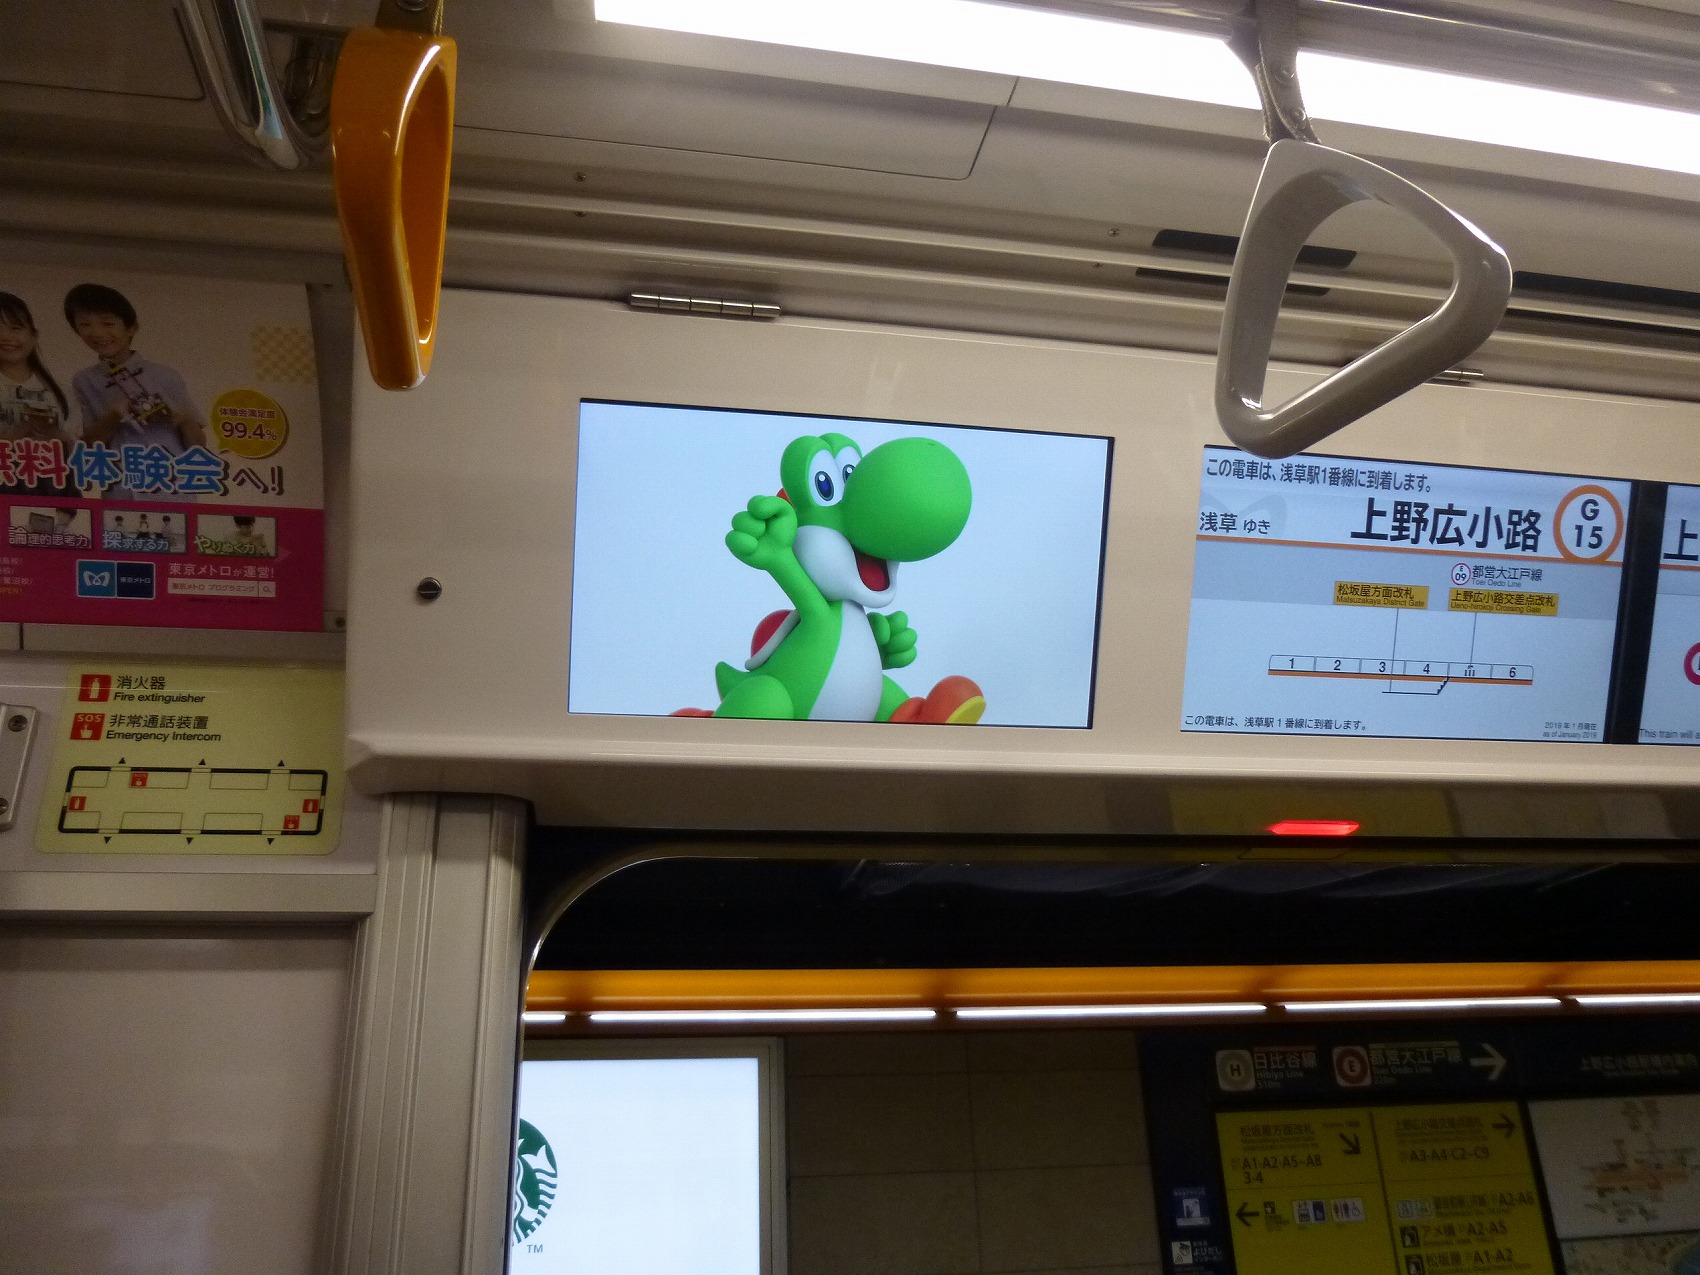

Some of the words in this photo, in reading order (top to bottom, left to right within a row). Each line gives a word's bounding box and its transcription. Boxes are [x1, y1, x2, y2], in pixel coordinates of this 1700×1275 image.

[219, 407, 276, 420] 体験会満足度
[221, 420, 277, 441] 99.4%
[1206, 458, 1432, 493] この電車は、浅草駅1番線に到着します。
[1580, 498, 1600, 521] G
[1199, 511, 1238, 534] 浅草
[1243, 519, 1271, 535] ゆき
[1350, 497, 1542, 553] 上野広小路
[8, 526, 89, 548] 論理的思考力
[103, 531, 169, 552] 探求する力
[1575, 524, 1603, 550] 15
[1663, 518, 1699, 562] 上
[1455, 573, 1467, 582] 09
[1472, 565, 1543, 582] 都営大江戸線
[1337, 583, 1415, 600] 松坂屋方面改札
[1451, 589, 1556, 608] 上野広小路交差点改札
[1336, 595, 1382, 606] Matsuzakaya
[1383, 598, 1407, 607] District
[1408, 600, 1425, 608] Gate
[1495, 604, 1524, 614] Crossing
[1526, 606, 1541, 614] Gate
[1289, 658, 1295, 669] 1
[1333, 659, 1341, 672] 2
[1378, 661, 1386, 673] 3
[1422, 663, 1430, 675] 4
[1508, 667, 1516, 678] 6
[117, 675, 166, 691] 消火器
[114, 691, 135, 702] Fire
[137, 693, 206, 705] extinguisher
[77, 714, 102, 723] SOS
[109, 714, 209, 730] 非常通話装置
[106, 730, 170, 743] Emergency
[172, 731, 222, 742] Intercom
[1558, 731, 1581, 740] January
[1639, 728, 1657, 738] This
[1659, 729, 1678, 739] train
[1680, 730, 1693, 739] will
[1254, 1051, 1319, 1070] 日比谷線
[1229, 1063, 1242, 1078] H
[1256, 1069, 1285, 1081] Hibiya
[1286, 1069, 1305, 1079] Line
[526, 1243, 544, 1254] TM
